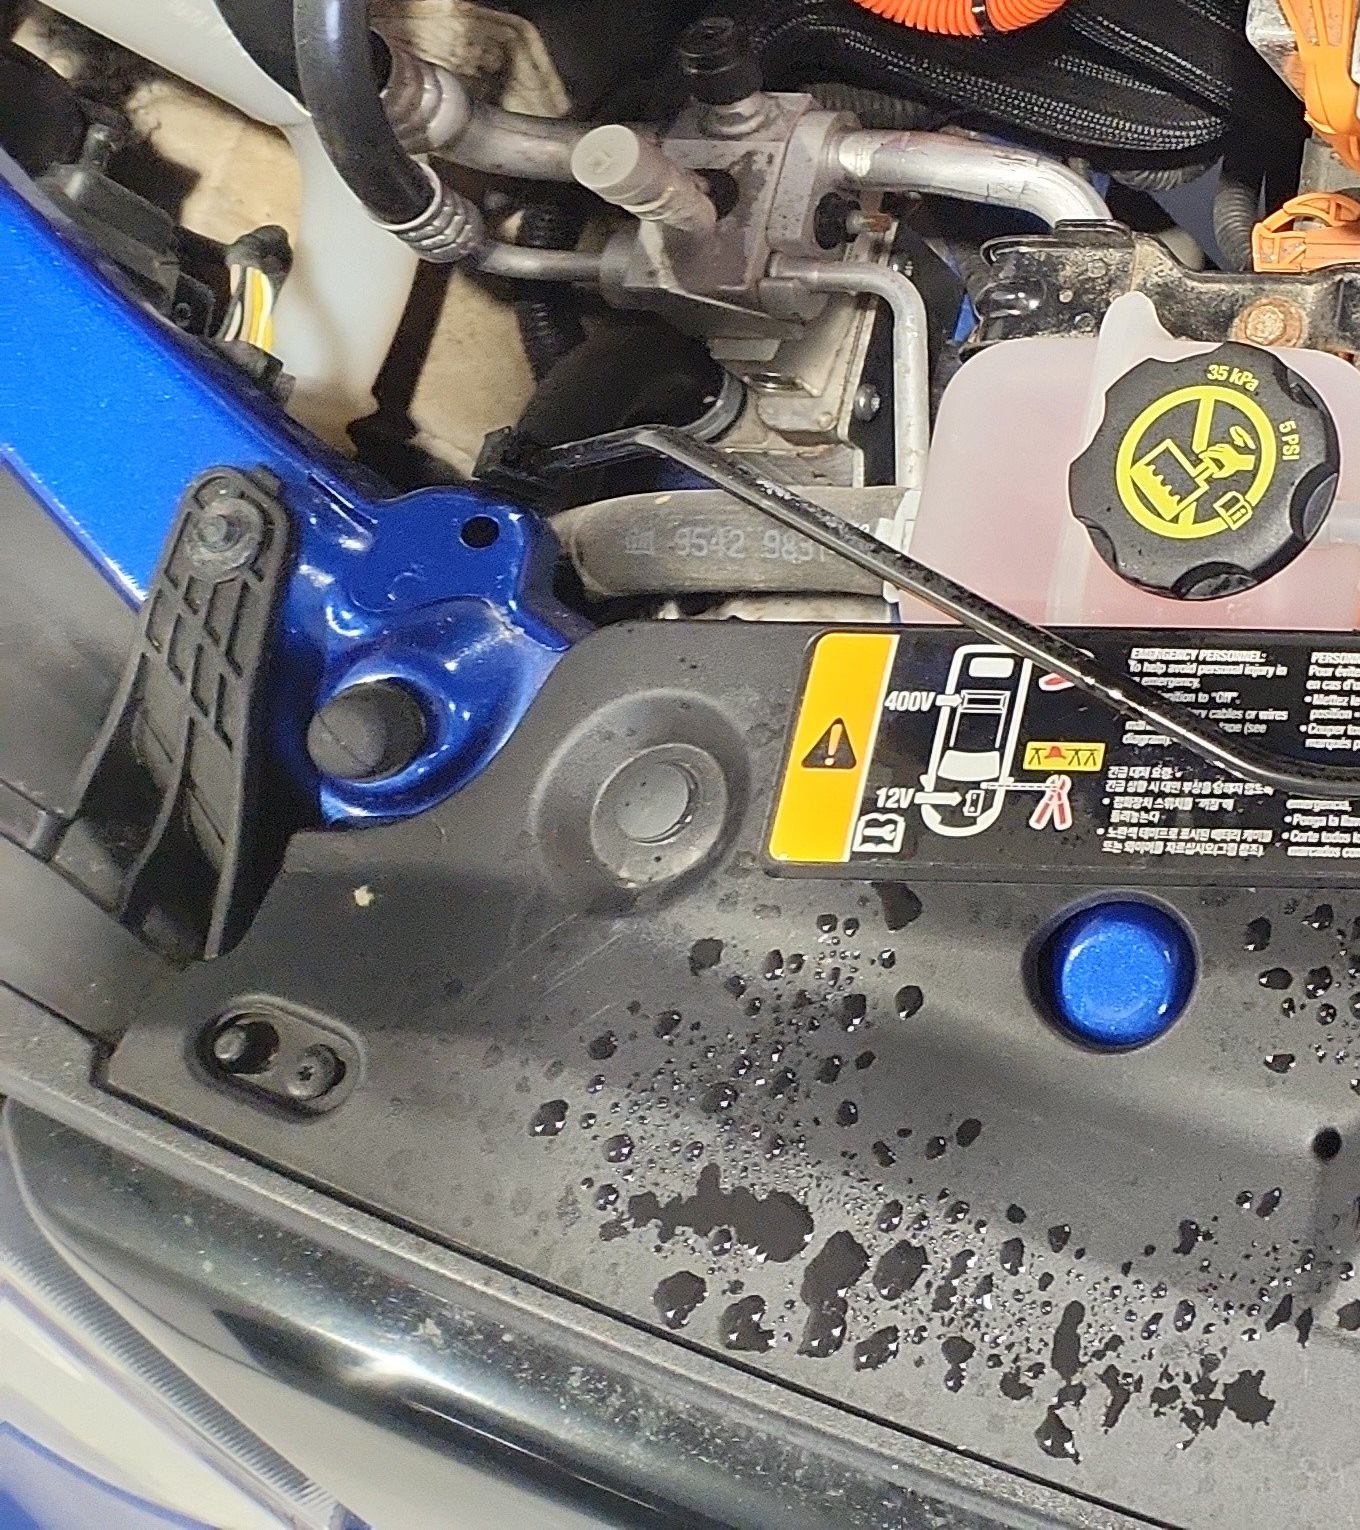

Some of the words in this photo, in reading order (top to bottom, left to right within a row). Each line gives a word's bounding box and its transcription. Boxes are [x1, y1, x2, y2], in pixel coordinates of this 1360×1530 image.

[1206, 364, 1230, 381] 35
[1229, 367, 1260, 392] kPa
[1278, 420, 1297, 433] 5
[1281, 433, 1300, 461] PSI
[1130, 648, 1199, 661] EMERGENCY
[1128, 660, 1141, 672] To
[1143, 661, 1167, 675] help
[1167, 662, 1198, 674] avoid
[1197, 664, 1243, 676] personal
[1244, 664, 1275, 678] injury
[1308, 664, 1334, 677] Pour
[1322, 680, 1342, 690] cas
[883, 690, 936, 712] 400V
[1312, 694, 1349, 707] Mettez
[1208, 708, 1244, 720] cables
[1245, 710, 1257, 720] or
[1258, 709, 1289, 720] wires
[1309, 708, 1352, 721] position
[875, 788, 916, 809] 12V
